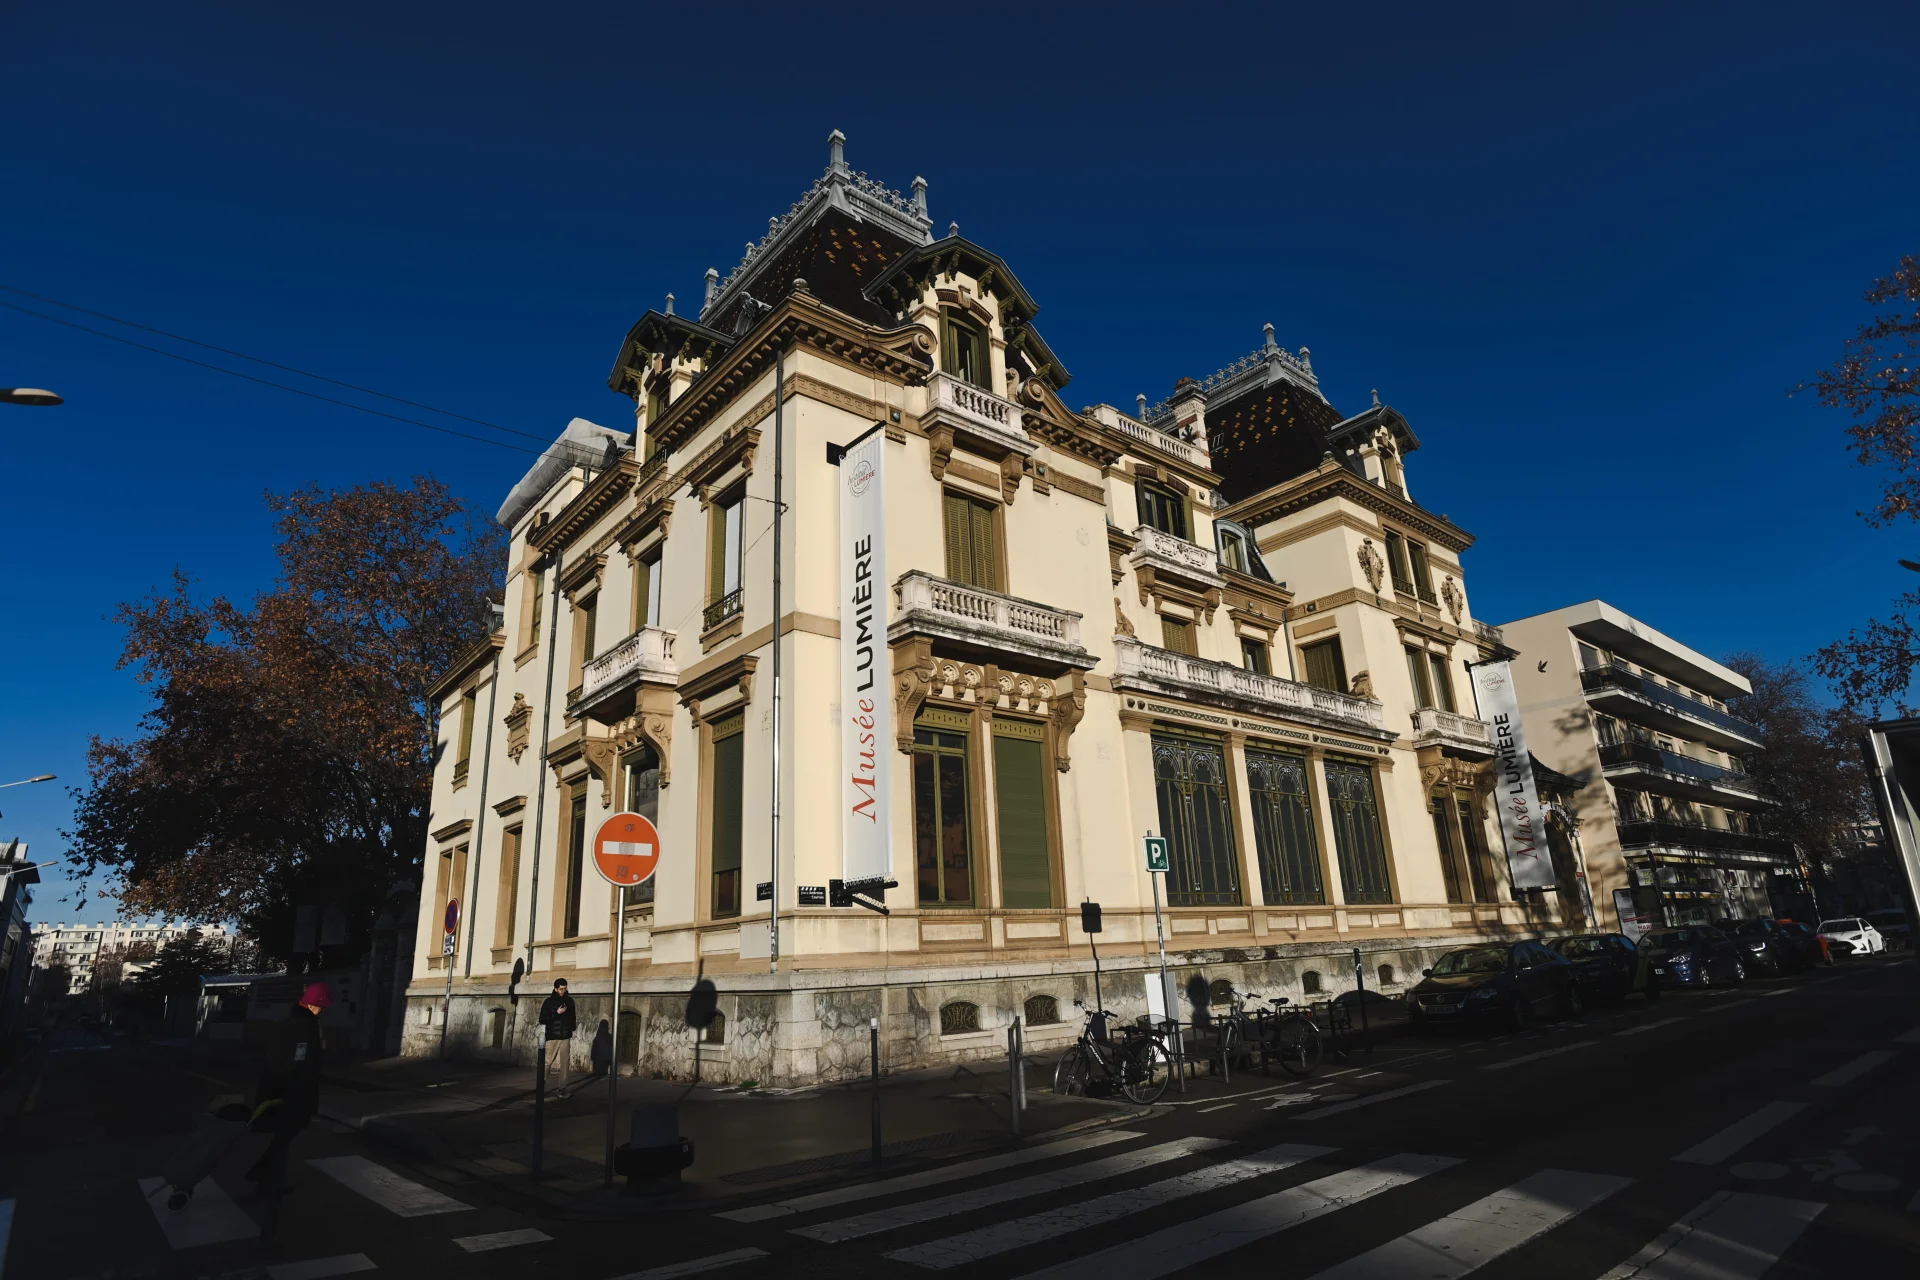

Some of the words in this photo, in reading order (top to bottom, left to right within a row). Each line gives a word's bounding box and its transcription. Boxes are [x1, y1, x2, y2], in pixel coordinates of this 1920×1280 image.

[852, 534, 874, 692] LUMIÈRE
[852, 698, 876, 824] Musée
[1494, 713, 1524, 794] LUMIÈRE
[1151, 843, 1161, 864] P
[1508, 797, 1538, 860] Musée
